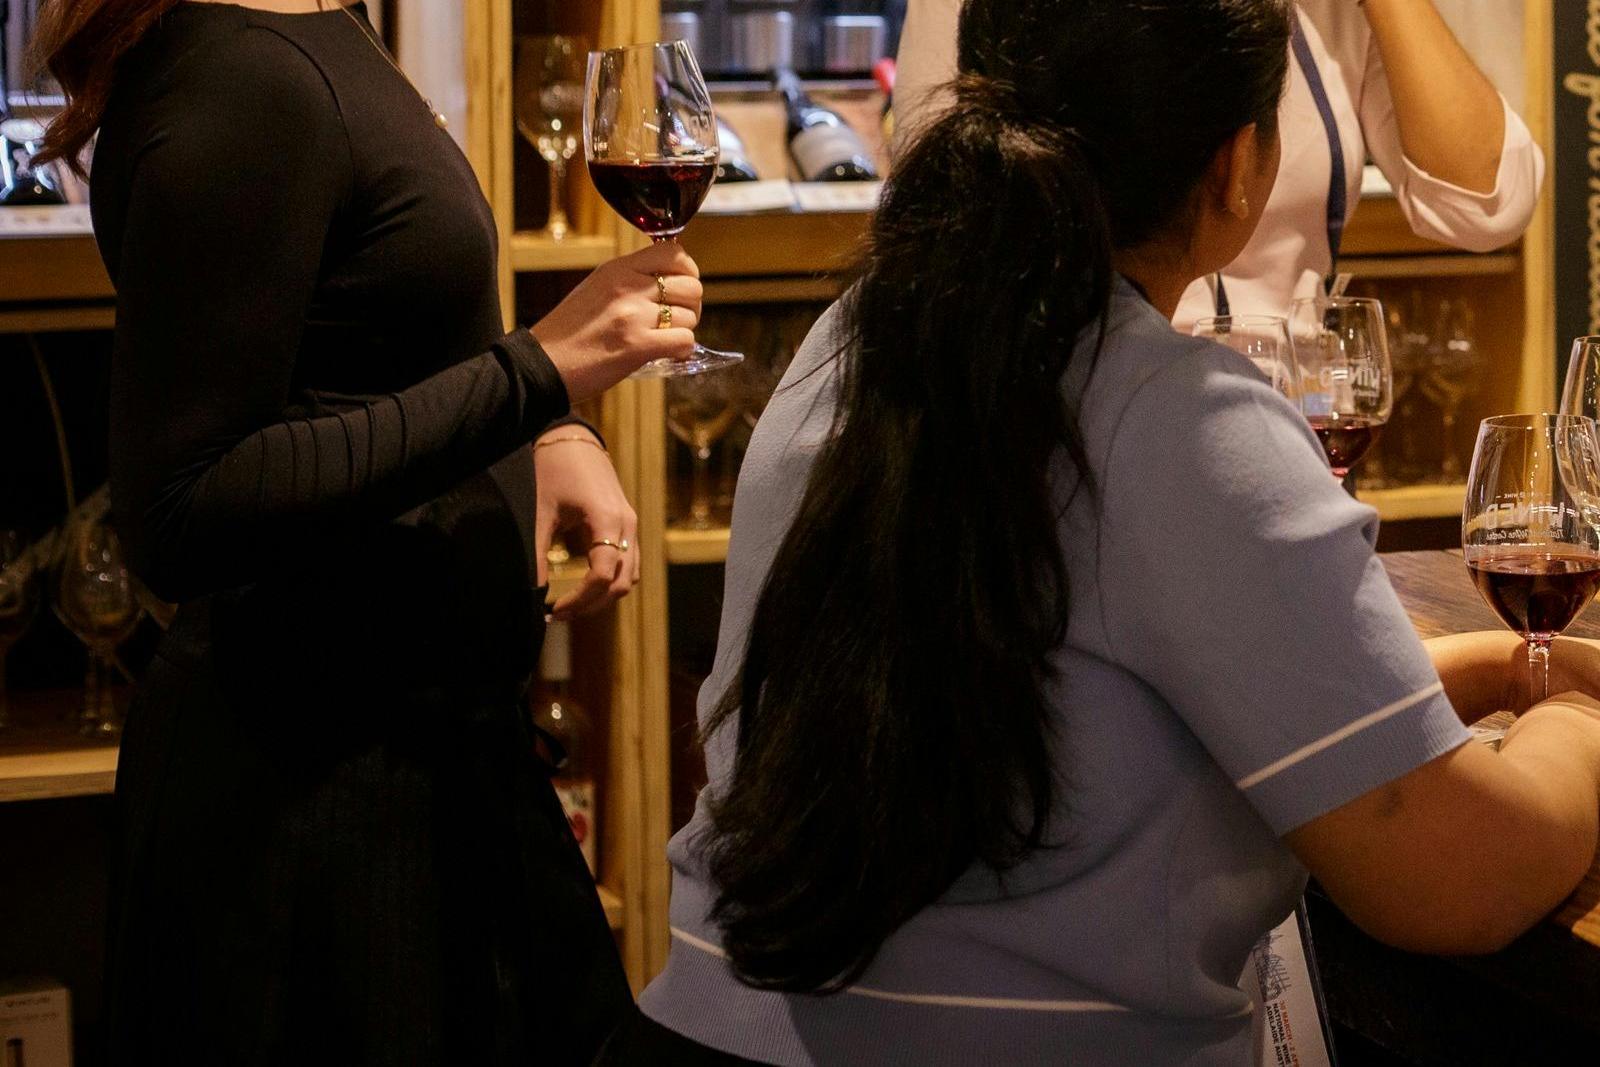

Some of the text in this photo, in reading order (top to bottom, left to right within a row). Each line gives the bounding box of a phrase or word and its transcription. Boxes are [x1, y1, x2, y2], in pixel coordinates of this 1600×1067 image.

[1266, 1005, 1280, 1044] ADELAIDE
[1273, 1003, 1292, 1065] NATIONAL WINE
[1281, 1012, 1293, 1040] MARCH
